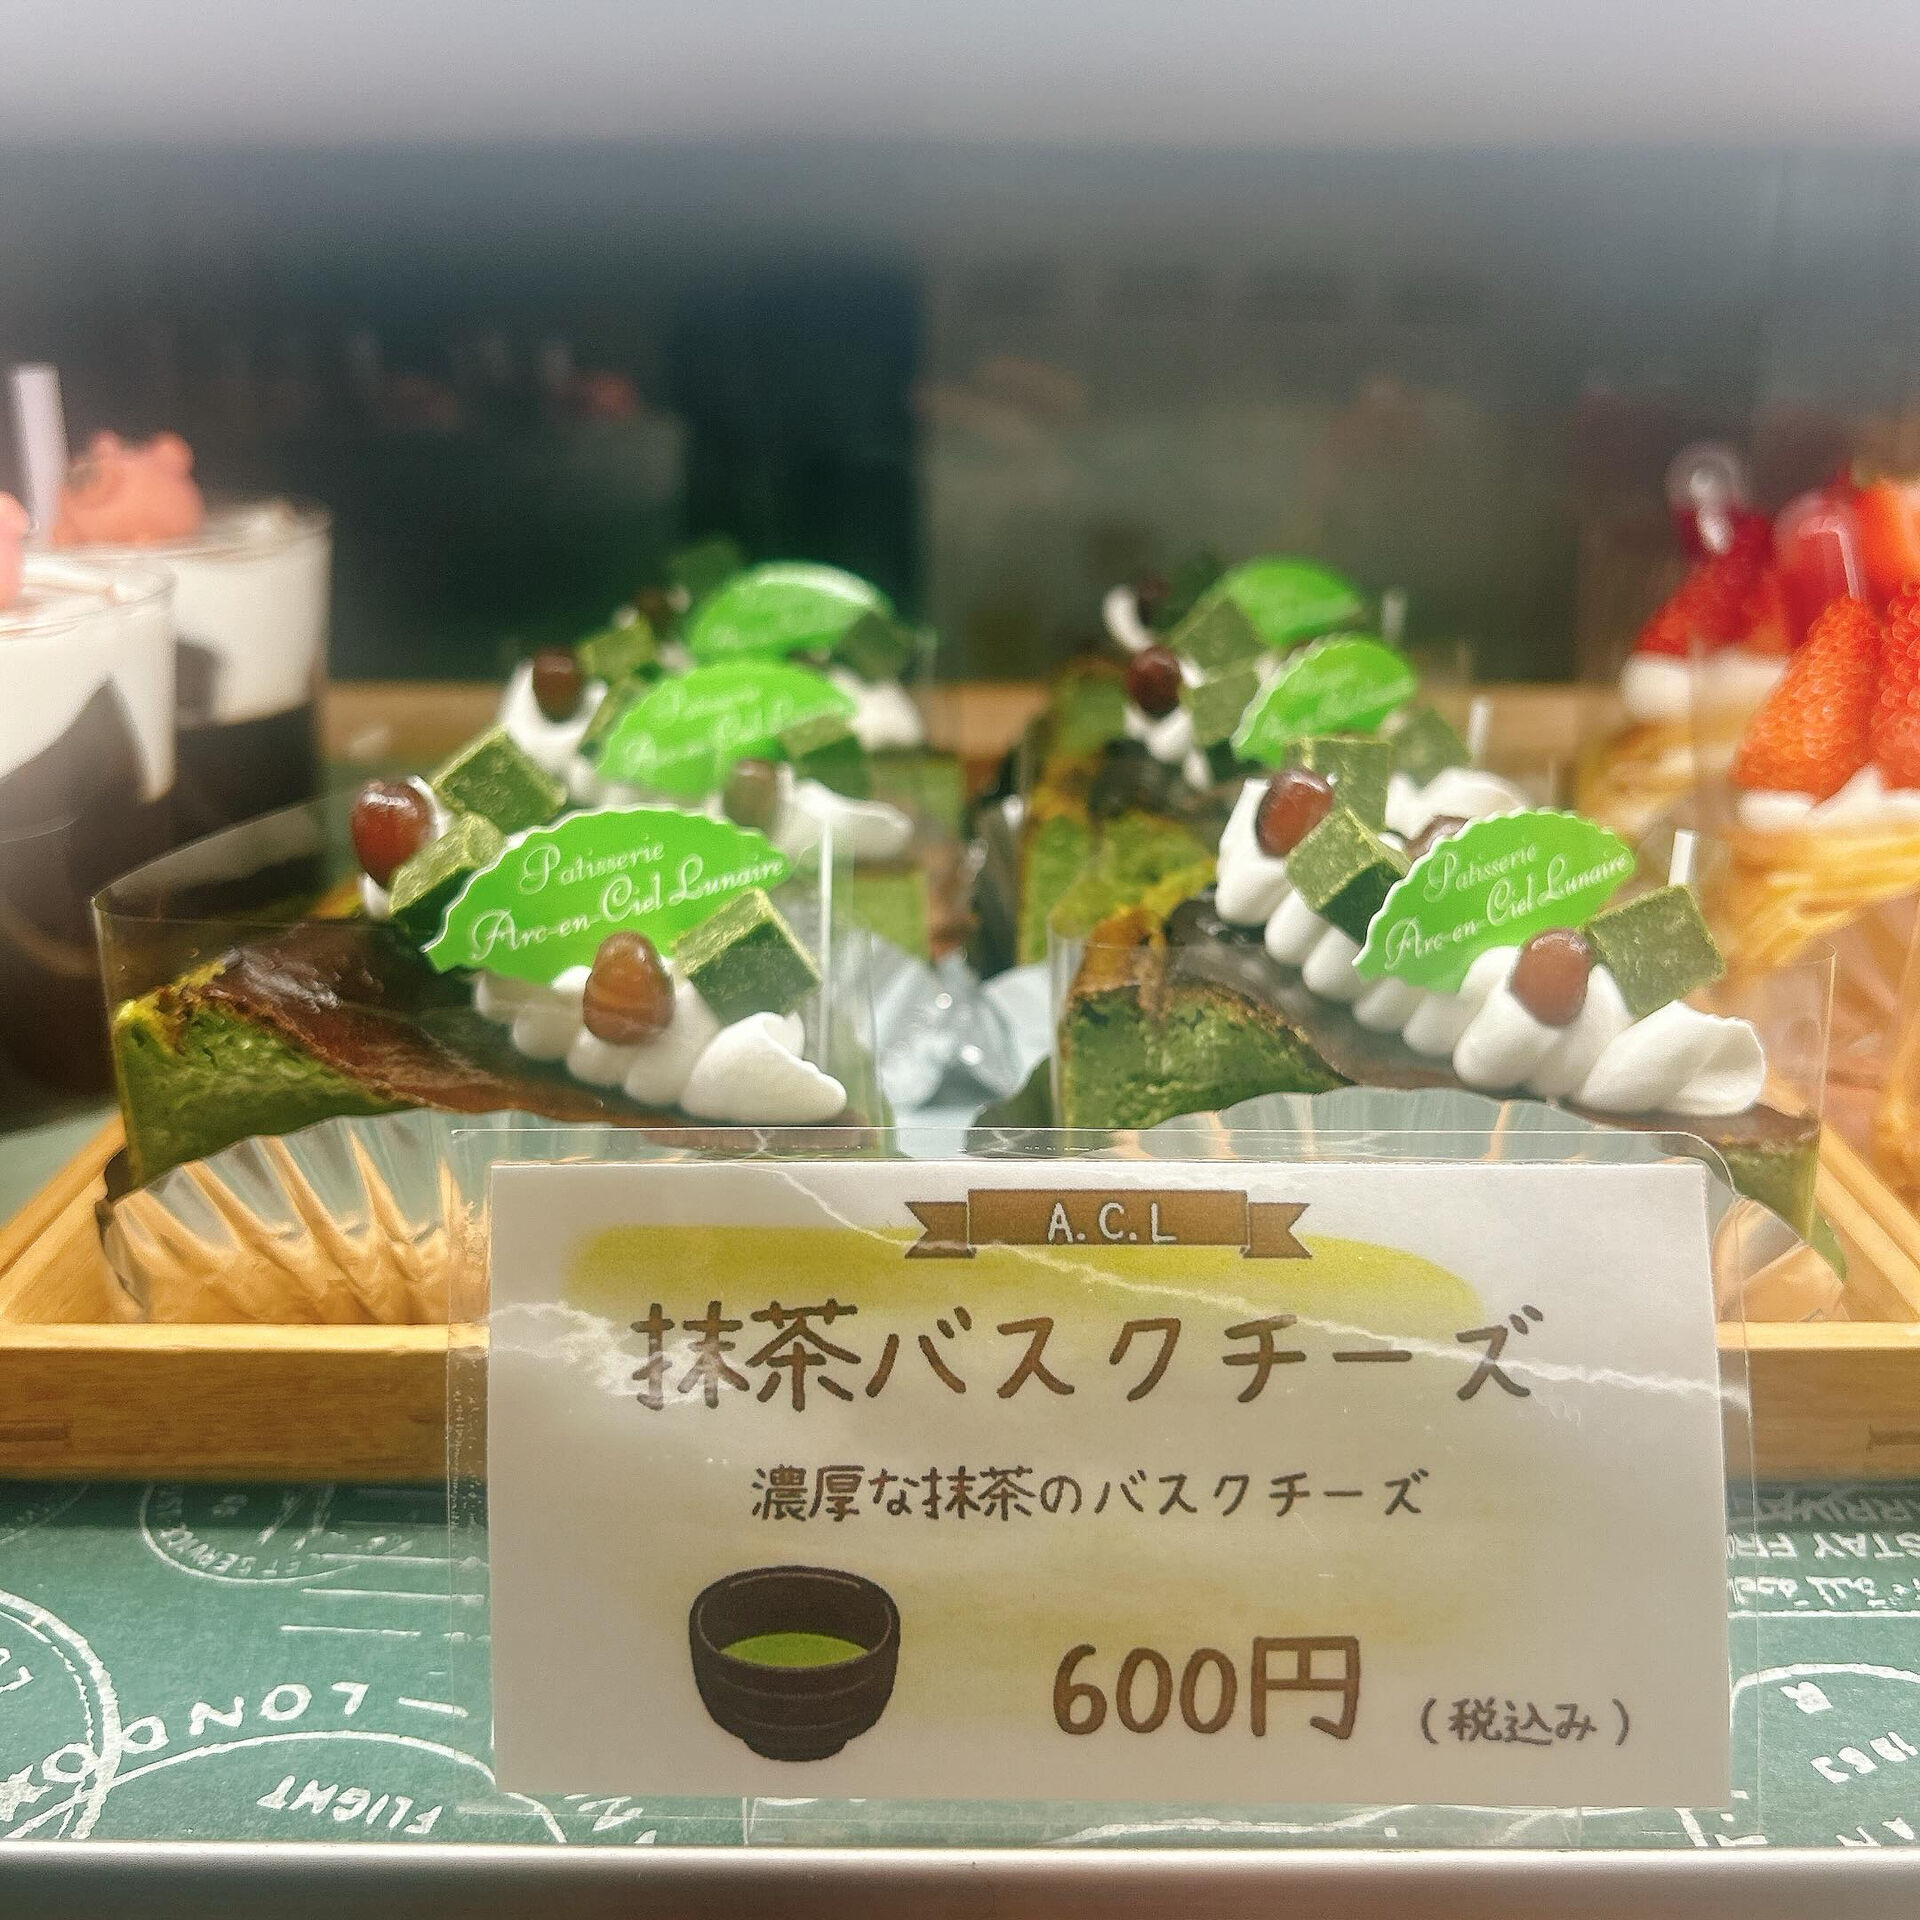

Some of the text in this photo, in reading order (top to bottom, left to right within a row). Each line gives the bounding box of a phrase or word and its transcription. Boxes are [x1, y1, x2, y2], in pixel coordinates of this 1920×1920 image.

[518, 833, 665, 896] Patisserie
[669, 852, 785, 907] Lunaire
[1423, 835, 1538, 903] Patisserie
[1536, 852, 1628, 906] Lunaire
[1047, 1202, 1178, 1243] A.C.L
[630, 1298, 1544, 1411] 抹茶バスクチーズ
[751, 1464, 1430, 1521] 濃厚な抹茶のバスクチーズ
[1053, 1636, 1361, 1740] 600円
[257, 1776, 443, 1834] FLIGHT
